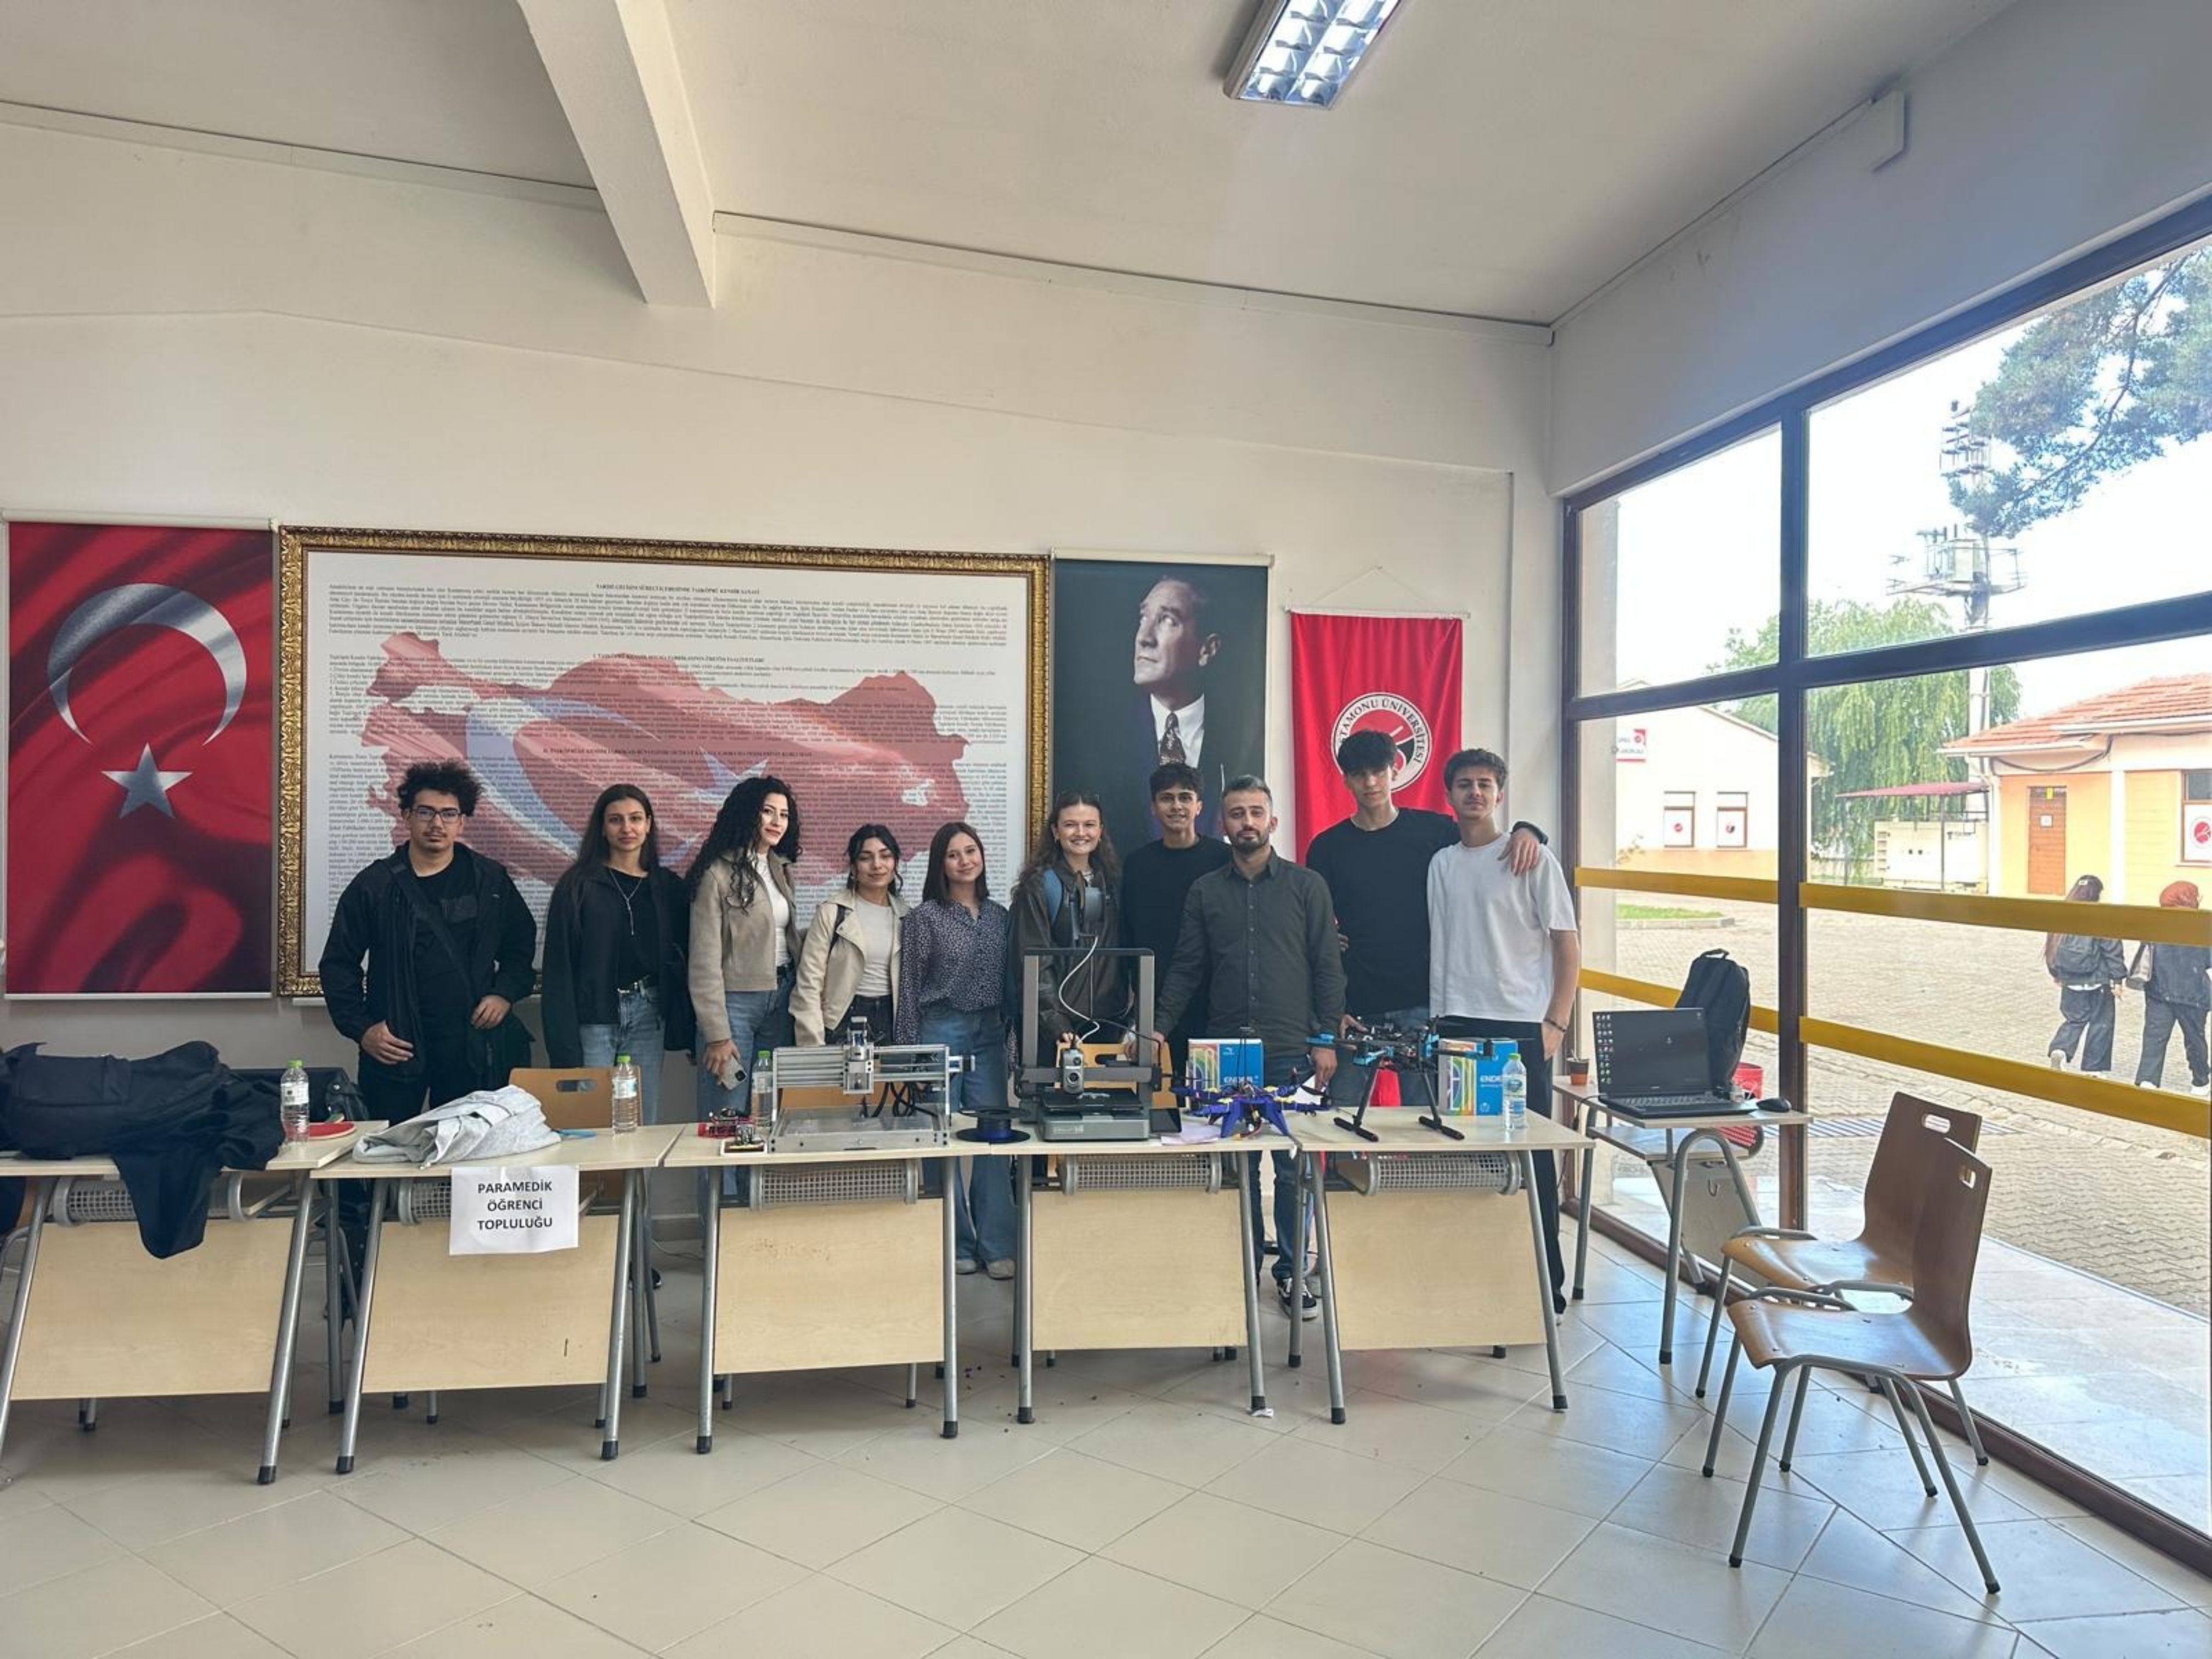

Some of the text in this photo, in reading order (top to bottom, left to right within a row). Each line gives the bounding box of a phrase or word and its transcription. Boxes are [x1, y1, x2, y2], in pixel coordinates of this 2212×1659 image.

[477, 1179, 552, 1193] PARAMEDİK
[487, 1197, 543, 1212] ÖĞRENCİ
[477, 1215, 552, 1231] TOPLULUĞU
